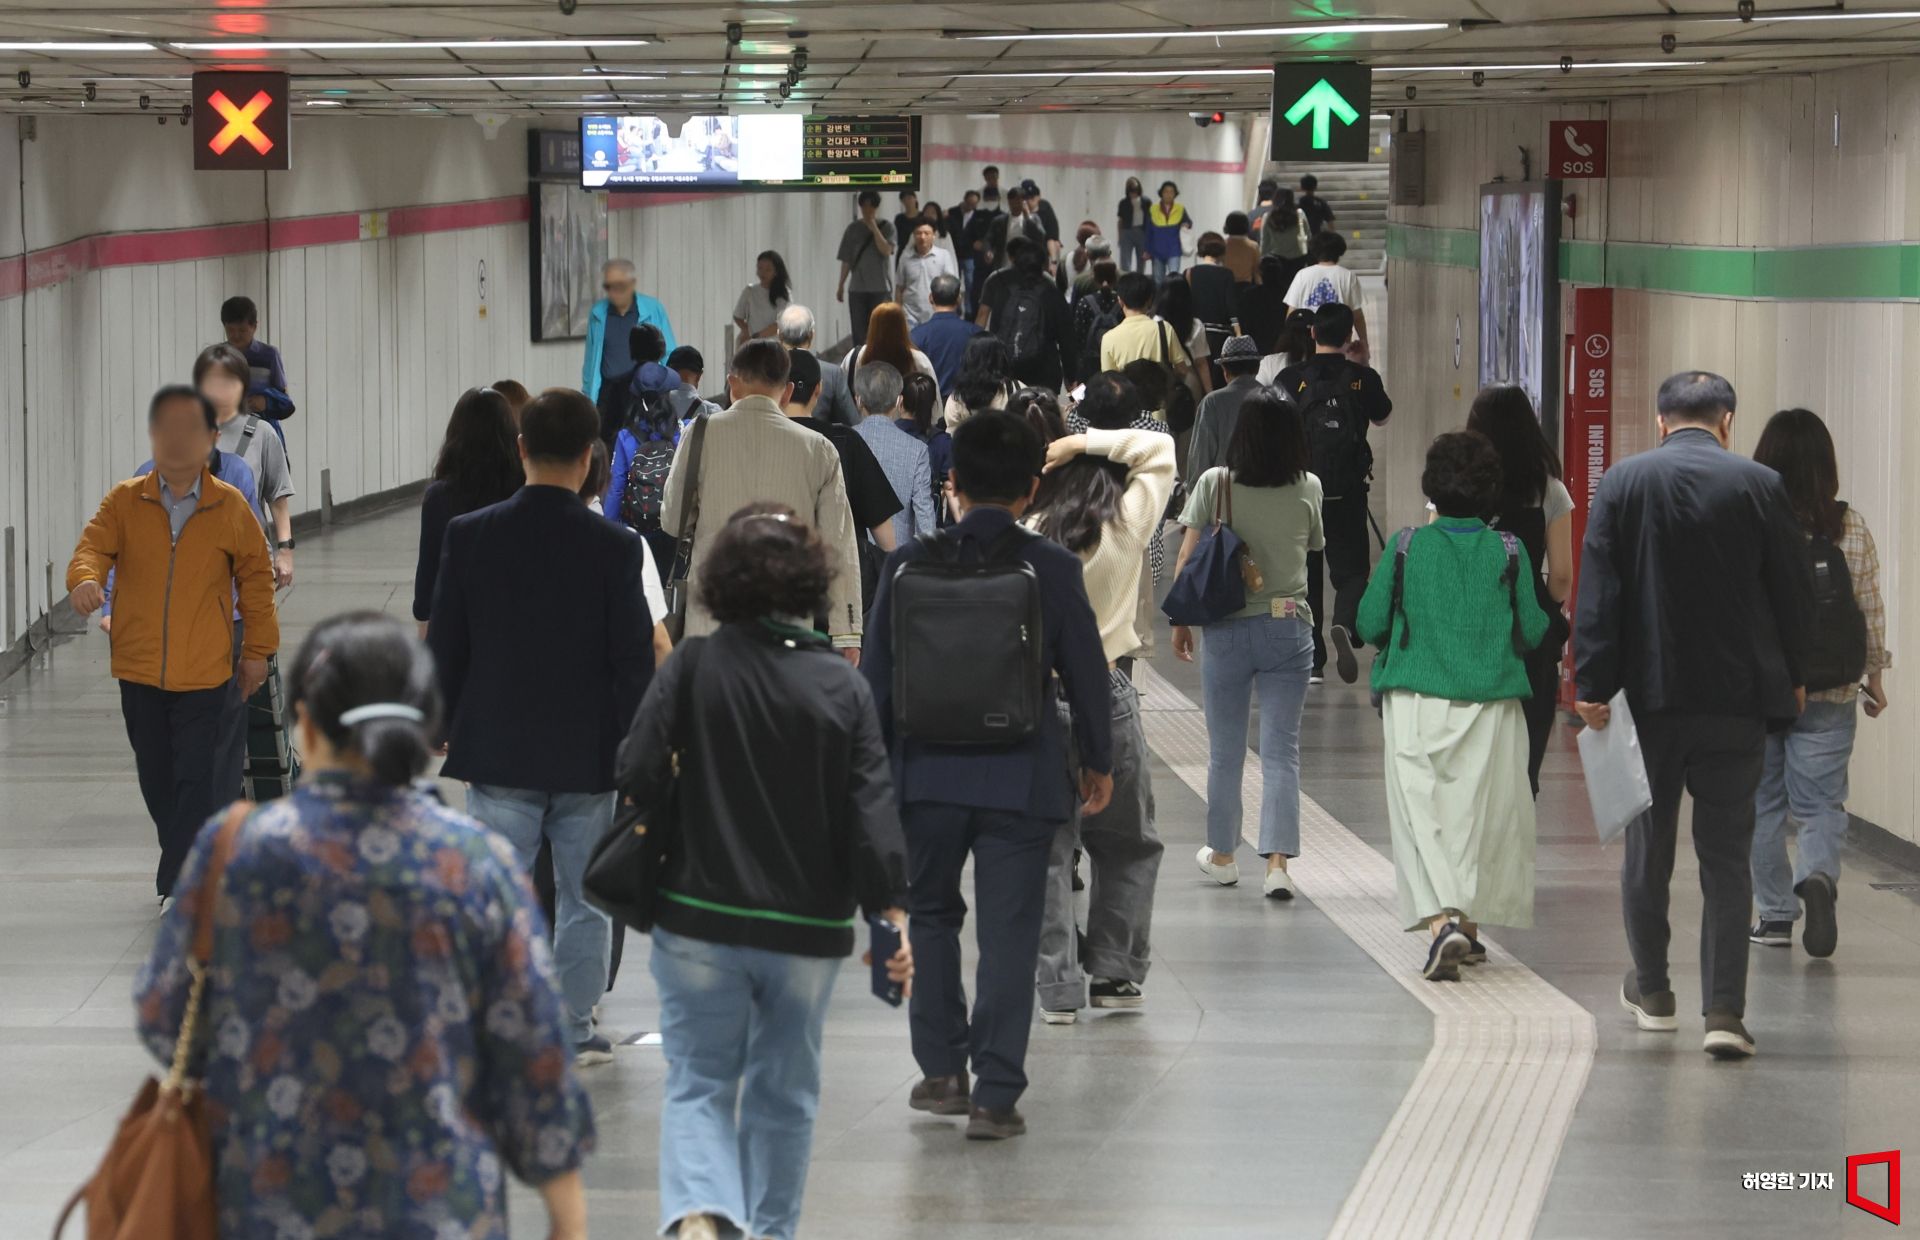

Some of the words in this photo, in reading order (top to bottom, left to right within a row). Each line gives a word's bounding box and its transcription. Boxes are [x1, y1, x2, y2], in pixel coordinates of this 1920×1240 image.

[803, 125, 822, 133] 순환
[826, 124, 850, 133] 강변역
[803, 137, 822, 146] 순환
[826, 136, 867, 146] 건대입구역
[803, 150, 822, 158] 순환
[826, 149, 859, 158] 한양대역
[1562, 161, 1594, 174] SOS
[1588, 368, 1605, 398] SOS
[1587, 424, 1604, 512] INFORMA
